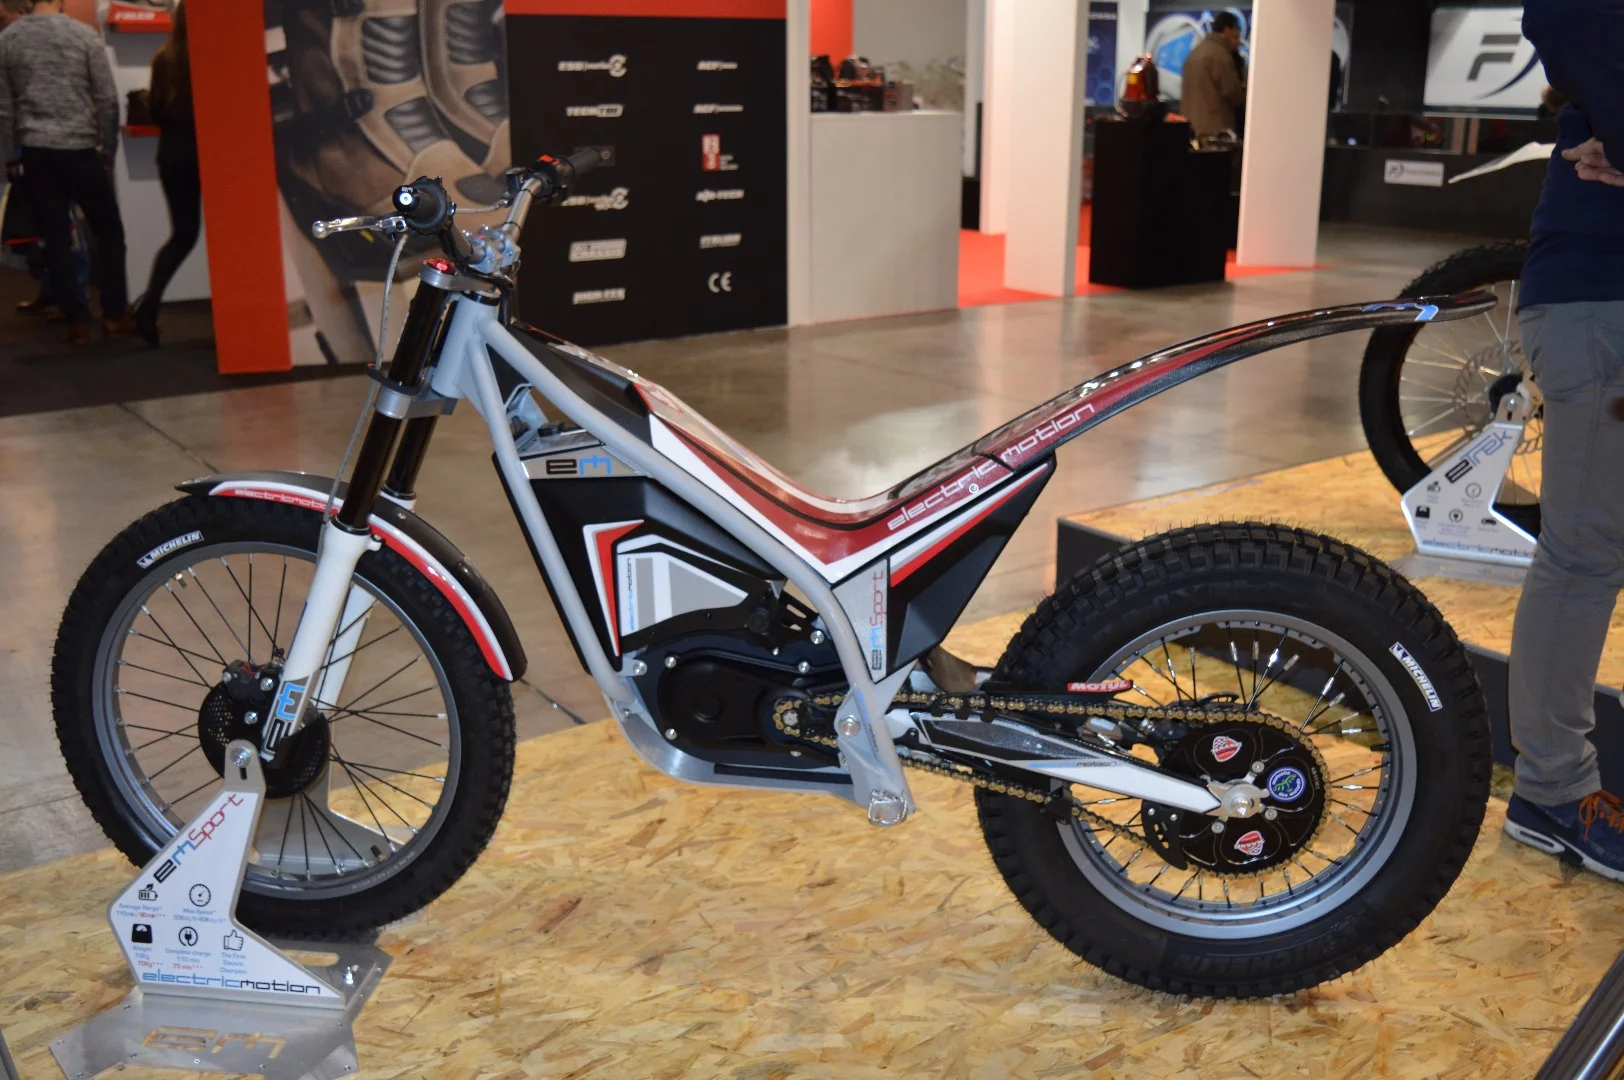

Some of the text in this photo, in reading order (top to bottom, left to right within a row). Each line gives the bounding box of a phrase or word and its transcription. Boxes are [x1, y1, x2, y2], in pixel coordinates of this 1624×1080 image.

[151, 532, 201, 560] MICHELIN
[1069, 680, 1129, 691] MOTUL
[1402, 656, 1441, 709] MICHELIN
